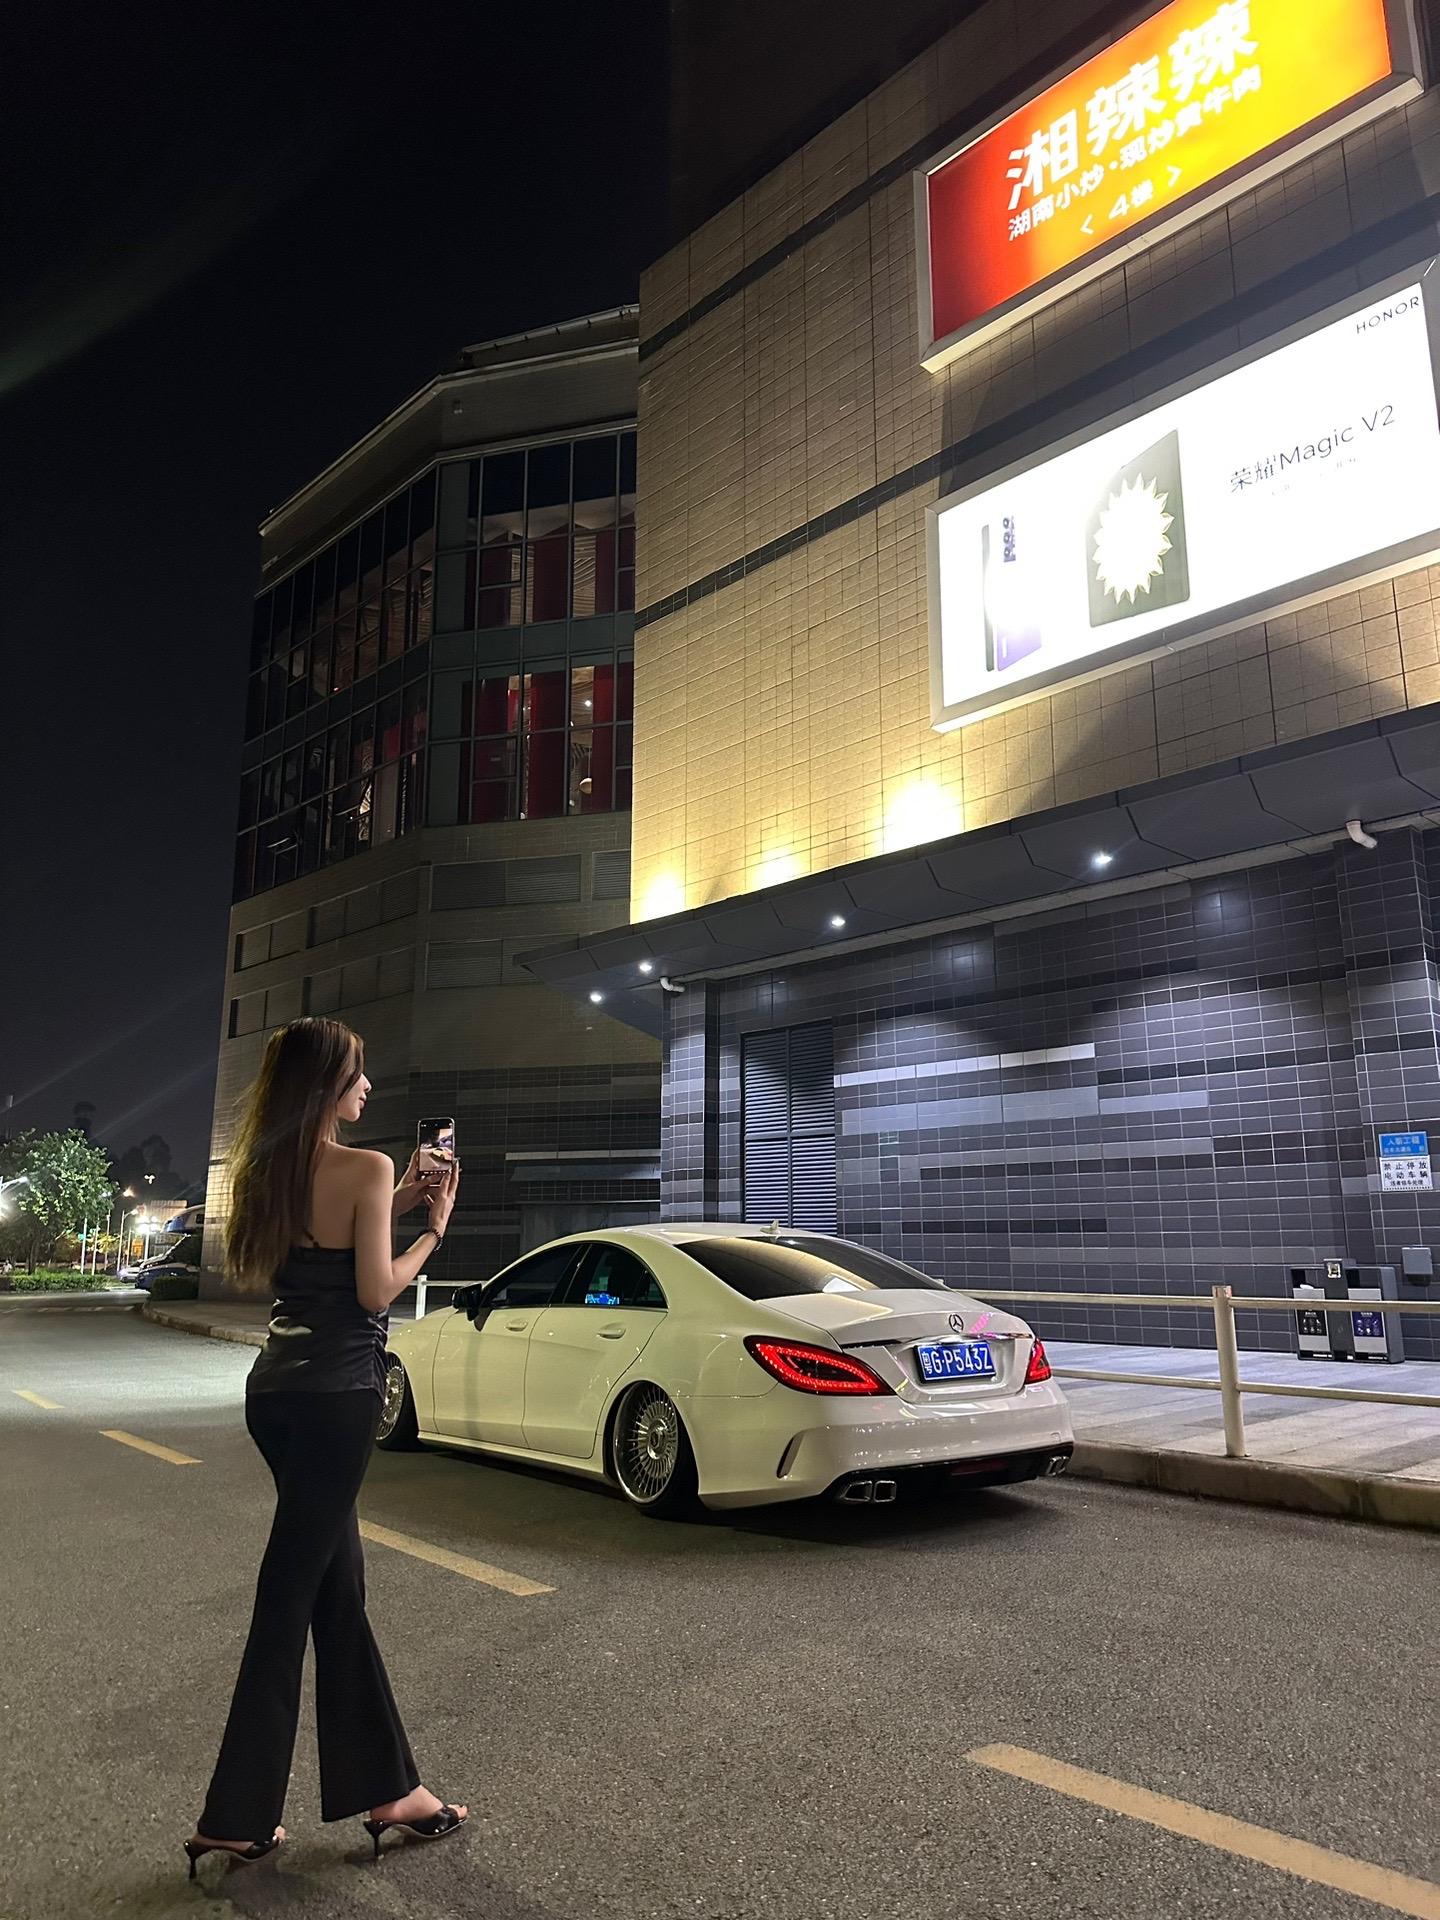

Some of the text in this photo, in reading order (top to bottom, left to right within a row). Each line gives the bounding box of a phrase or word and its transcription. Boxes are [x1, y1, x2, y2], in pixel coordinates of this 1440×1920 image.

[1006, 0, 1260, 211] 湘辣辣
[1356, 296, 1420, 334] HONOR
[1361, 404, 1396, 431] V2
